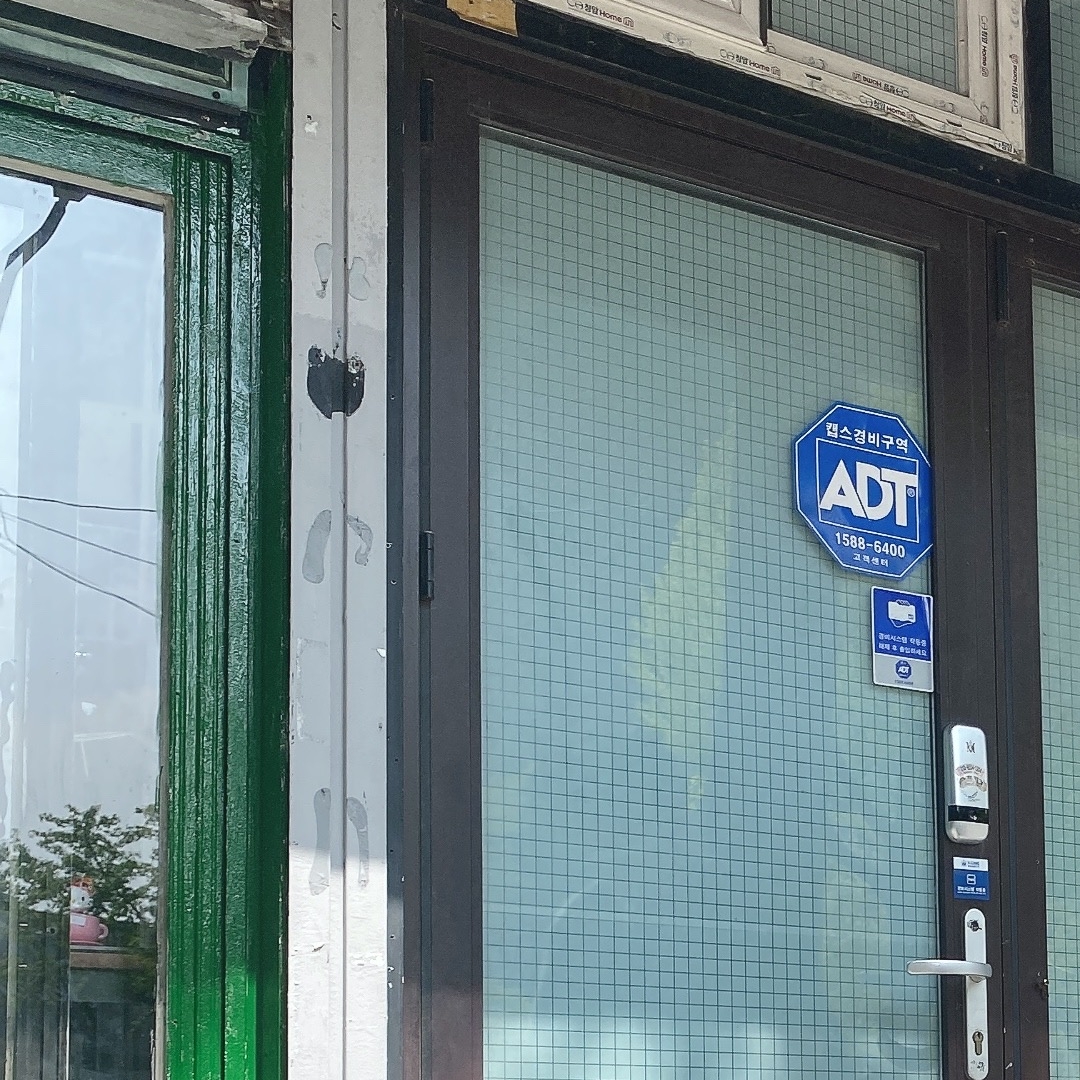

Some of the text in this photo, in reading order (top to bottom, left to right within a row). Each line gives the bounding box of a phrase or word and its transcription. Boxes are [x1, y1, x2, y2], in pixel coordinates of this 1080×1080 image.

[599, 10, 623, 23] Home
[749, 59, 771, 73] Home
[886, 105, 906, 118] Home
[826, 421, 908, 453] 캡스경비구역
[820, 459, 918, 527] ADT
[835, 531, 906, 558] 1588-6400
[852, 553, 889, 567] 고객센터
